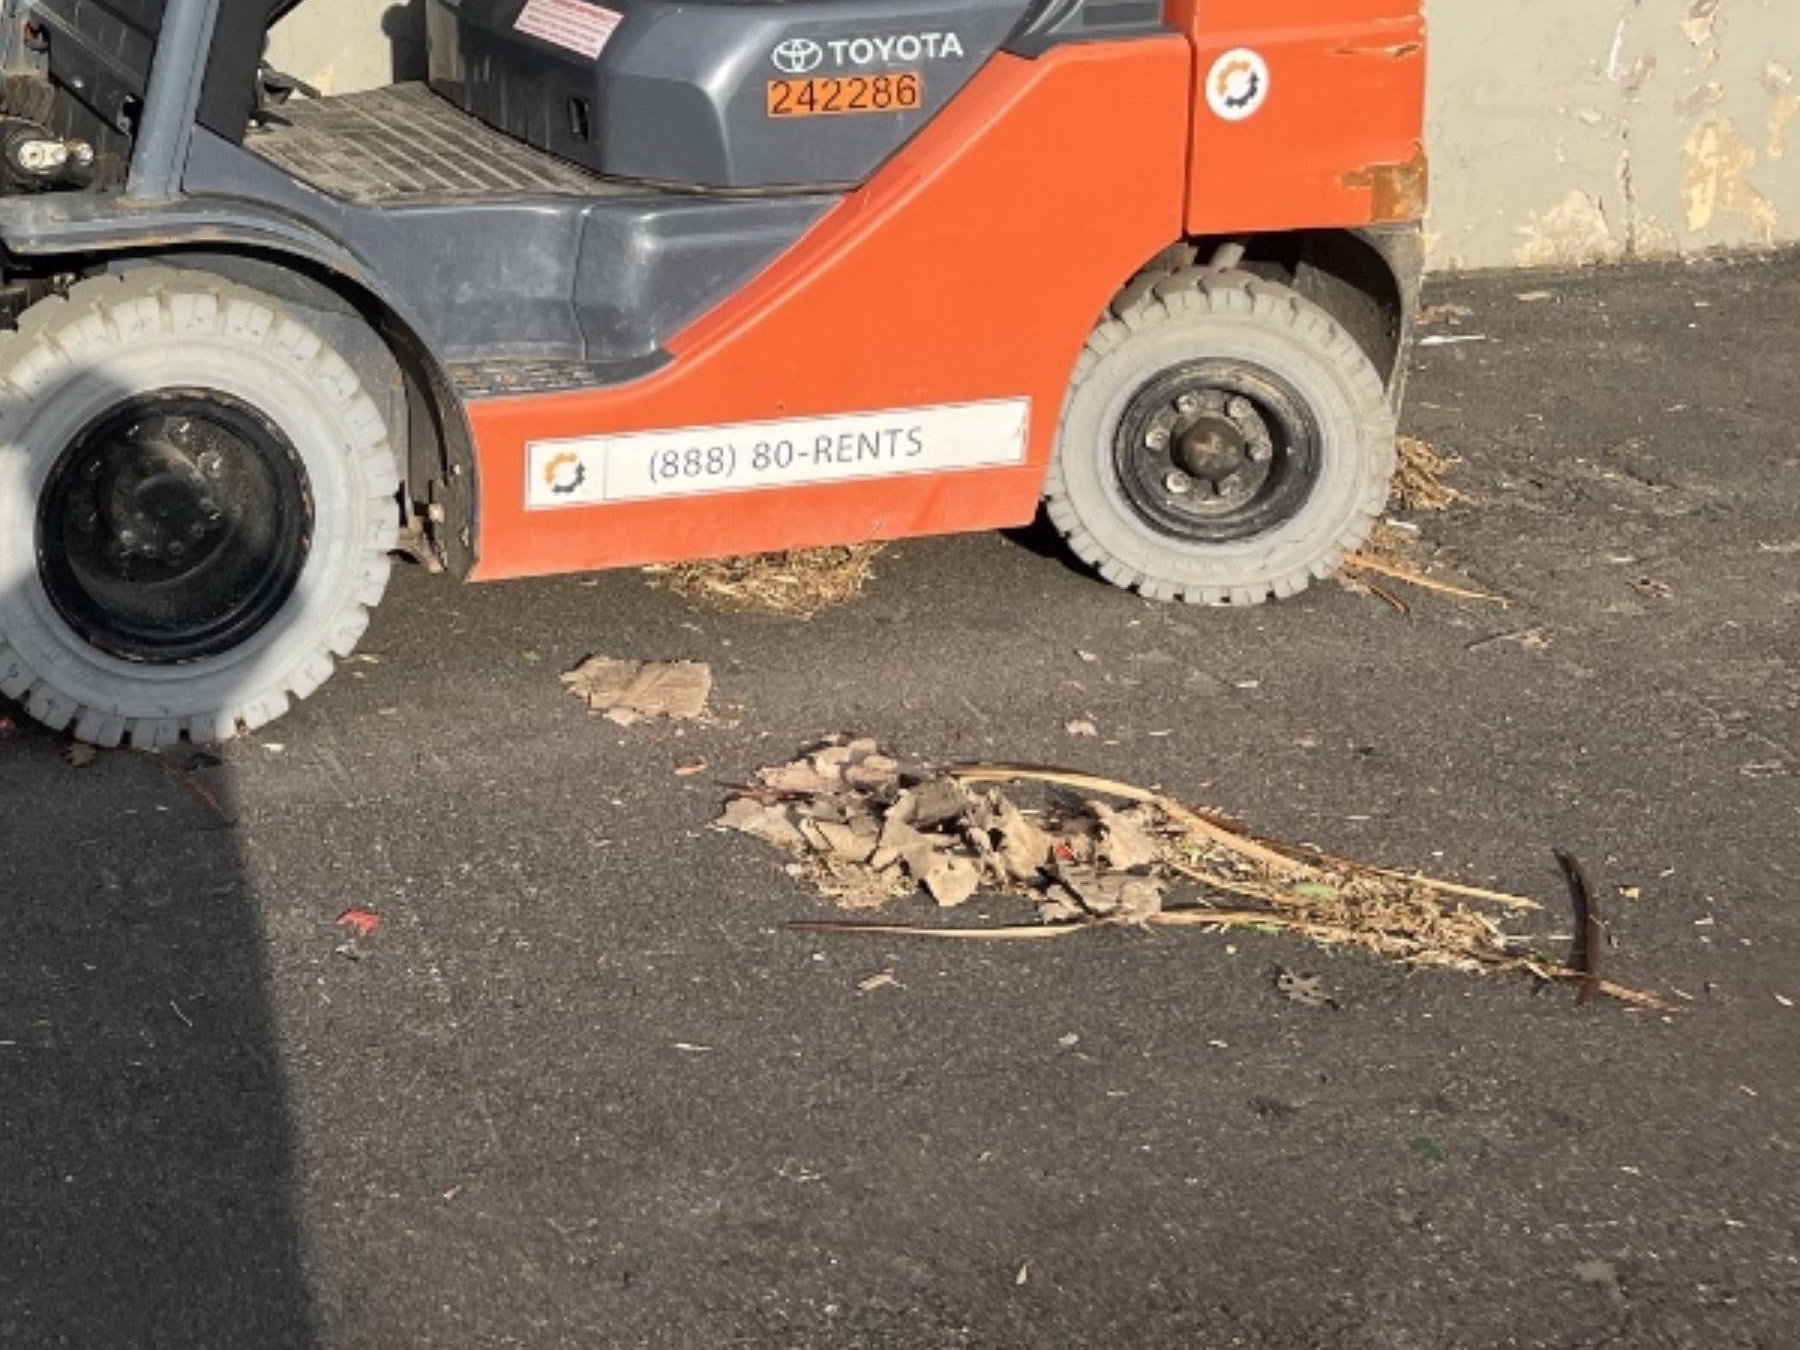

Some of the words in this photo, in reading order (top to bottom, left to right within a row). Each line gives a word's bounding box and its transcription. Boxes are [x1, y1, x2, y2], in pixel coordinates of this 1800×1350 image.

[828, 32, 964, 66] TOYOTA
[771, 74, 917, 114] 242286
[649, 444, 737, 483] (888)
[752, 426, 923, 471] 80-RENTS
